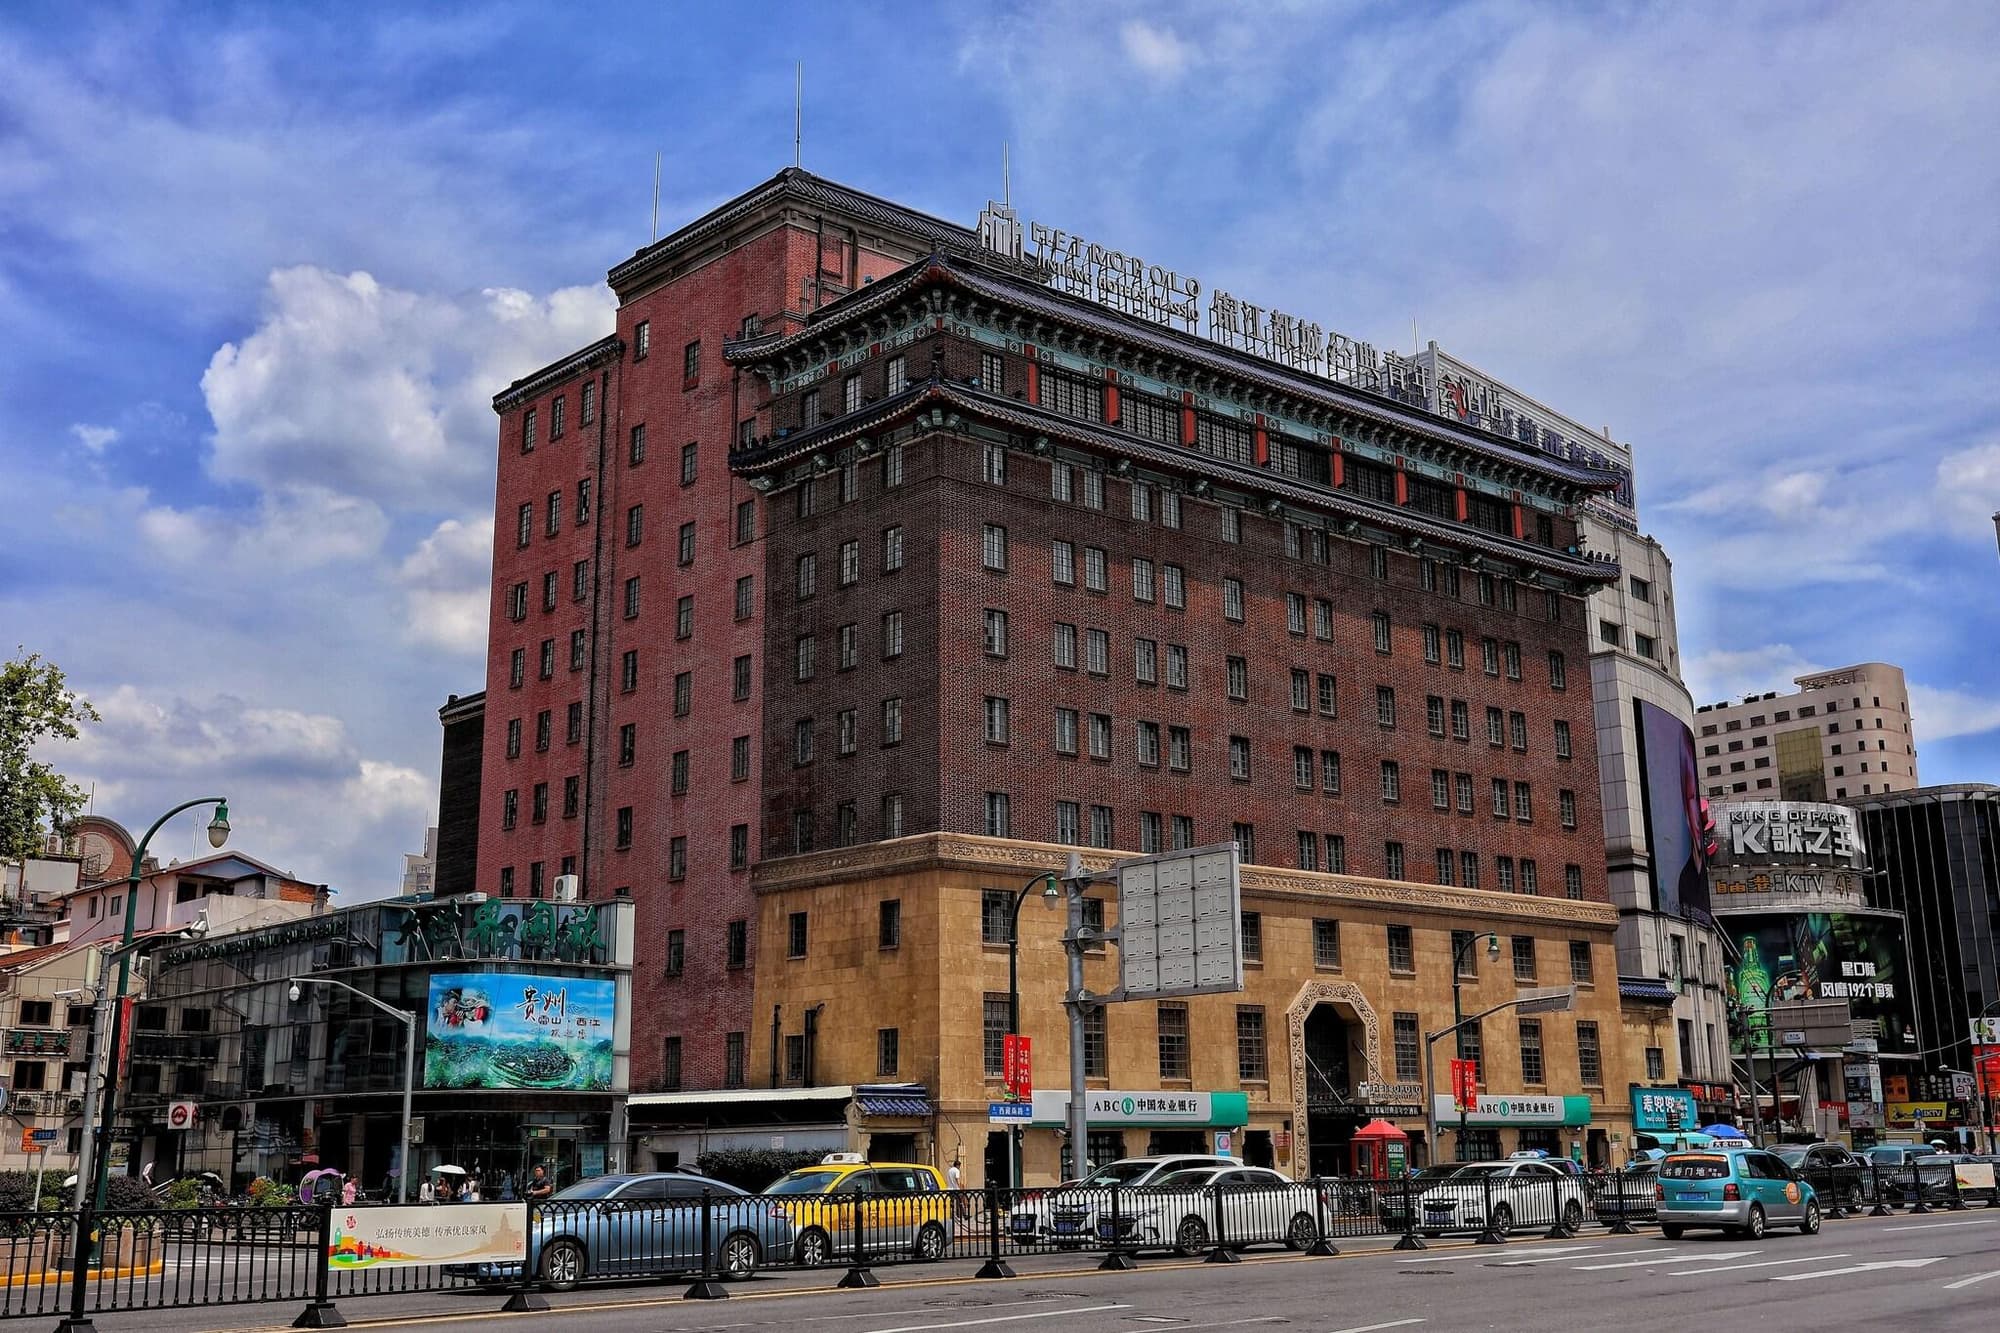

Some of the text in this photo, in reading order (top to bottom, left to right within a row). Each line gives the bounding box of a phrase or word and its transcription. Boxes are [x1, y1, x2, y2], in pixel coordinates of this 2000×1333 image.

[1730, 811, 1849, 825] KING OF PARTY
[1732, 822, 1854, 857] K歌之王
[1093, 1098, 1198, 1112] ABC 中国农业银行
[1480, 1102, 1555, 1113] ABC 中国农业银行
[375, 1224, 487, 1239] 弘扬传统美德 传承优良家风
